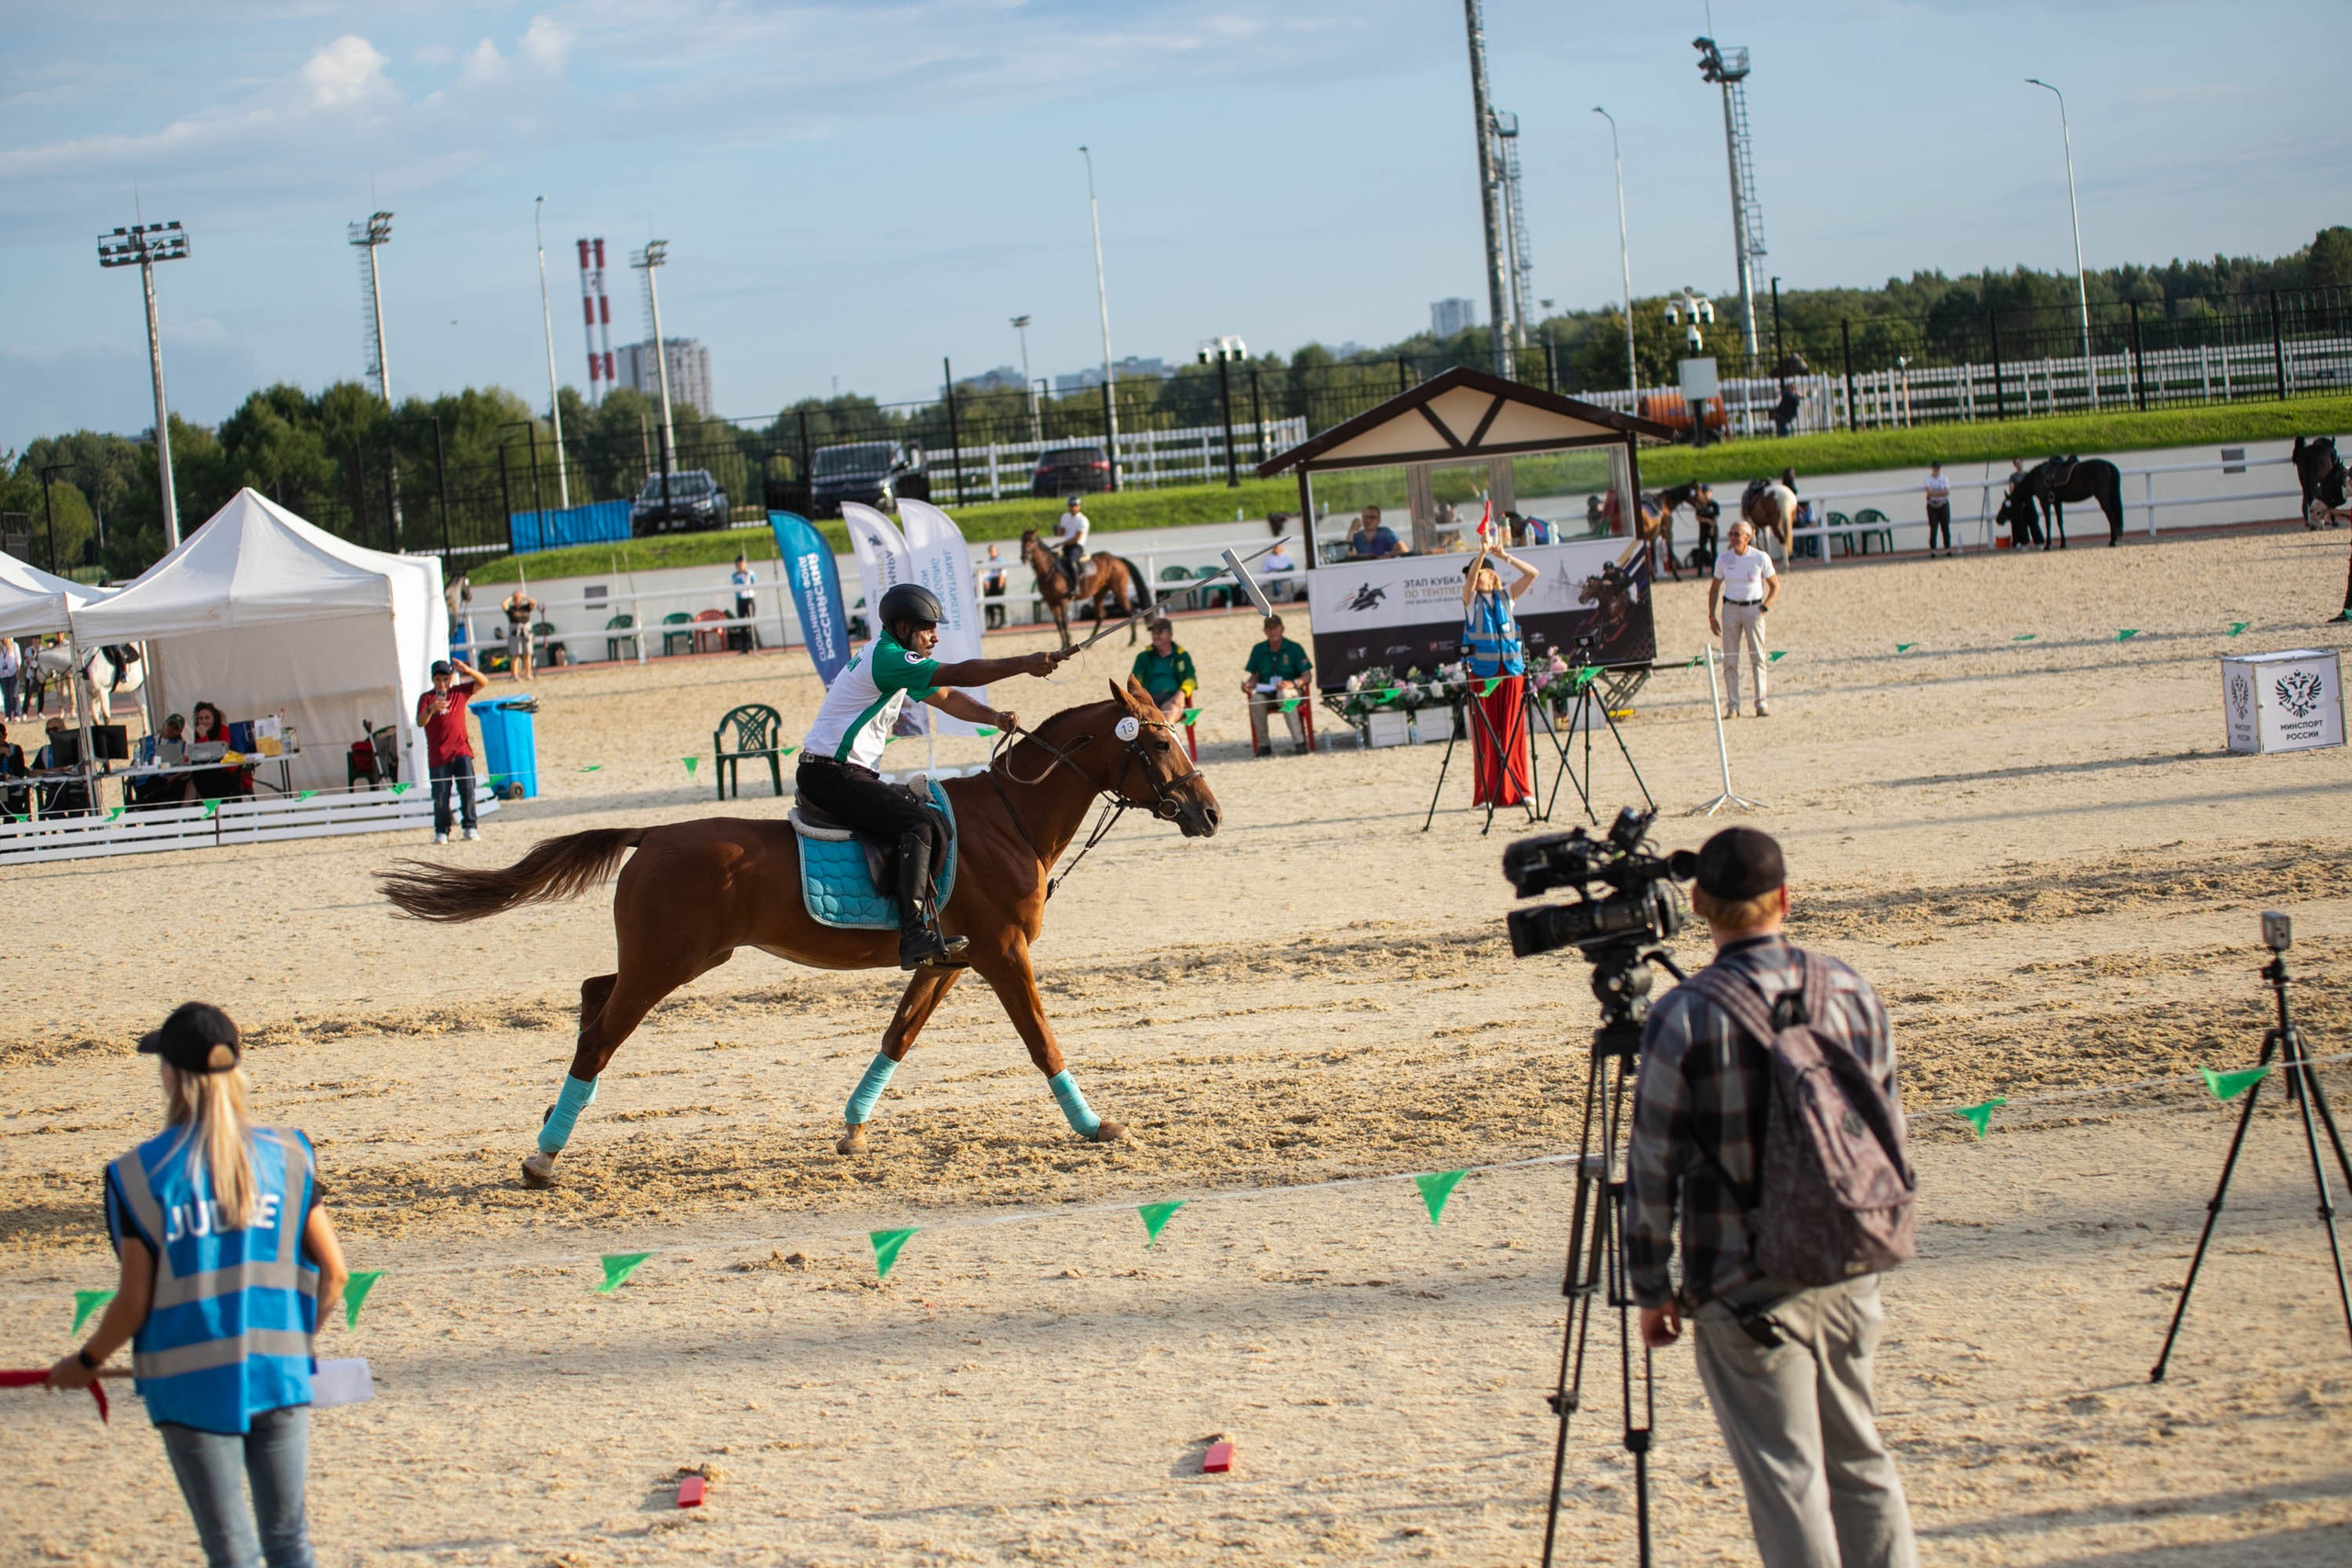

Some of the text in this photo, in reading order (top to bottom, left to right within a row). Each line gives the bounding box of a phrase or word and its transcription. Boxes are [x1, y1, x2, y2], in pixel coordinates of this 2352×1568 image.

[1404, 576, 1463, 588] ЭТАП КУБКА
[1405, 585, 1463, 599] ПО ТЕНТПЕГ
[1121, 722, 1135, 734] 13
[2280, 720, 2323, 731] МИНСПОРТ
[2286, 730, 2319, 740] РОССИИ
[167, 1193, 280, 1243] JUDE
